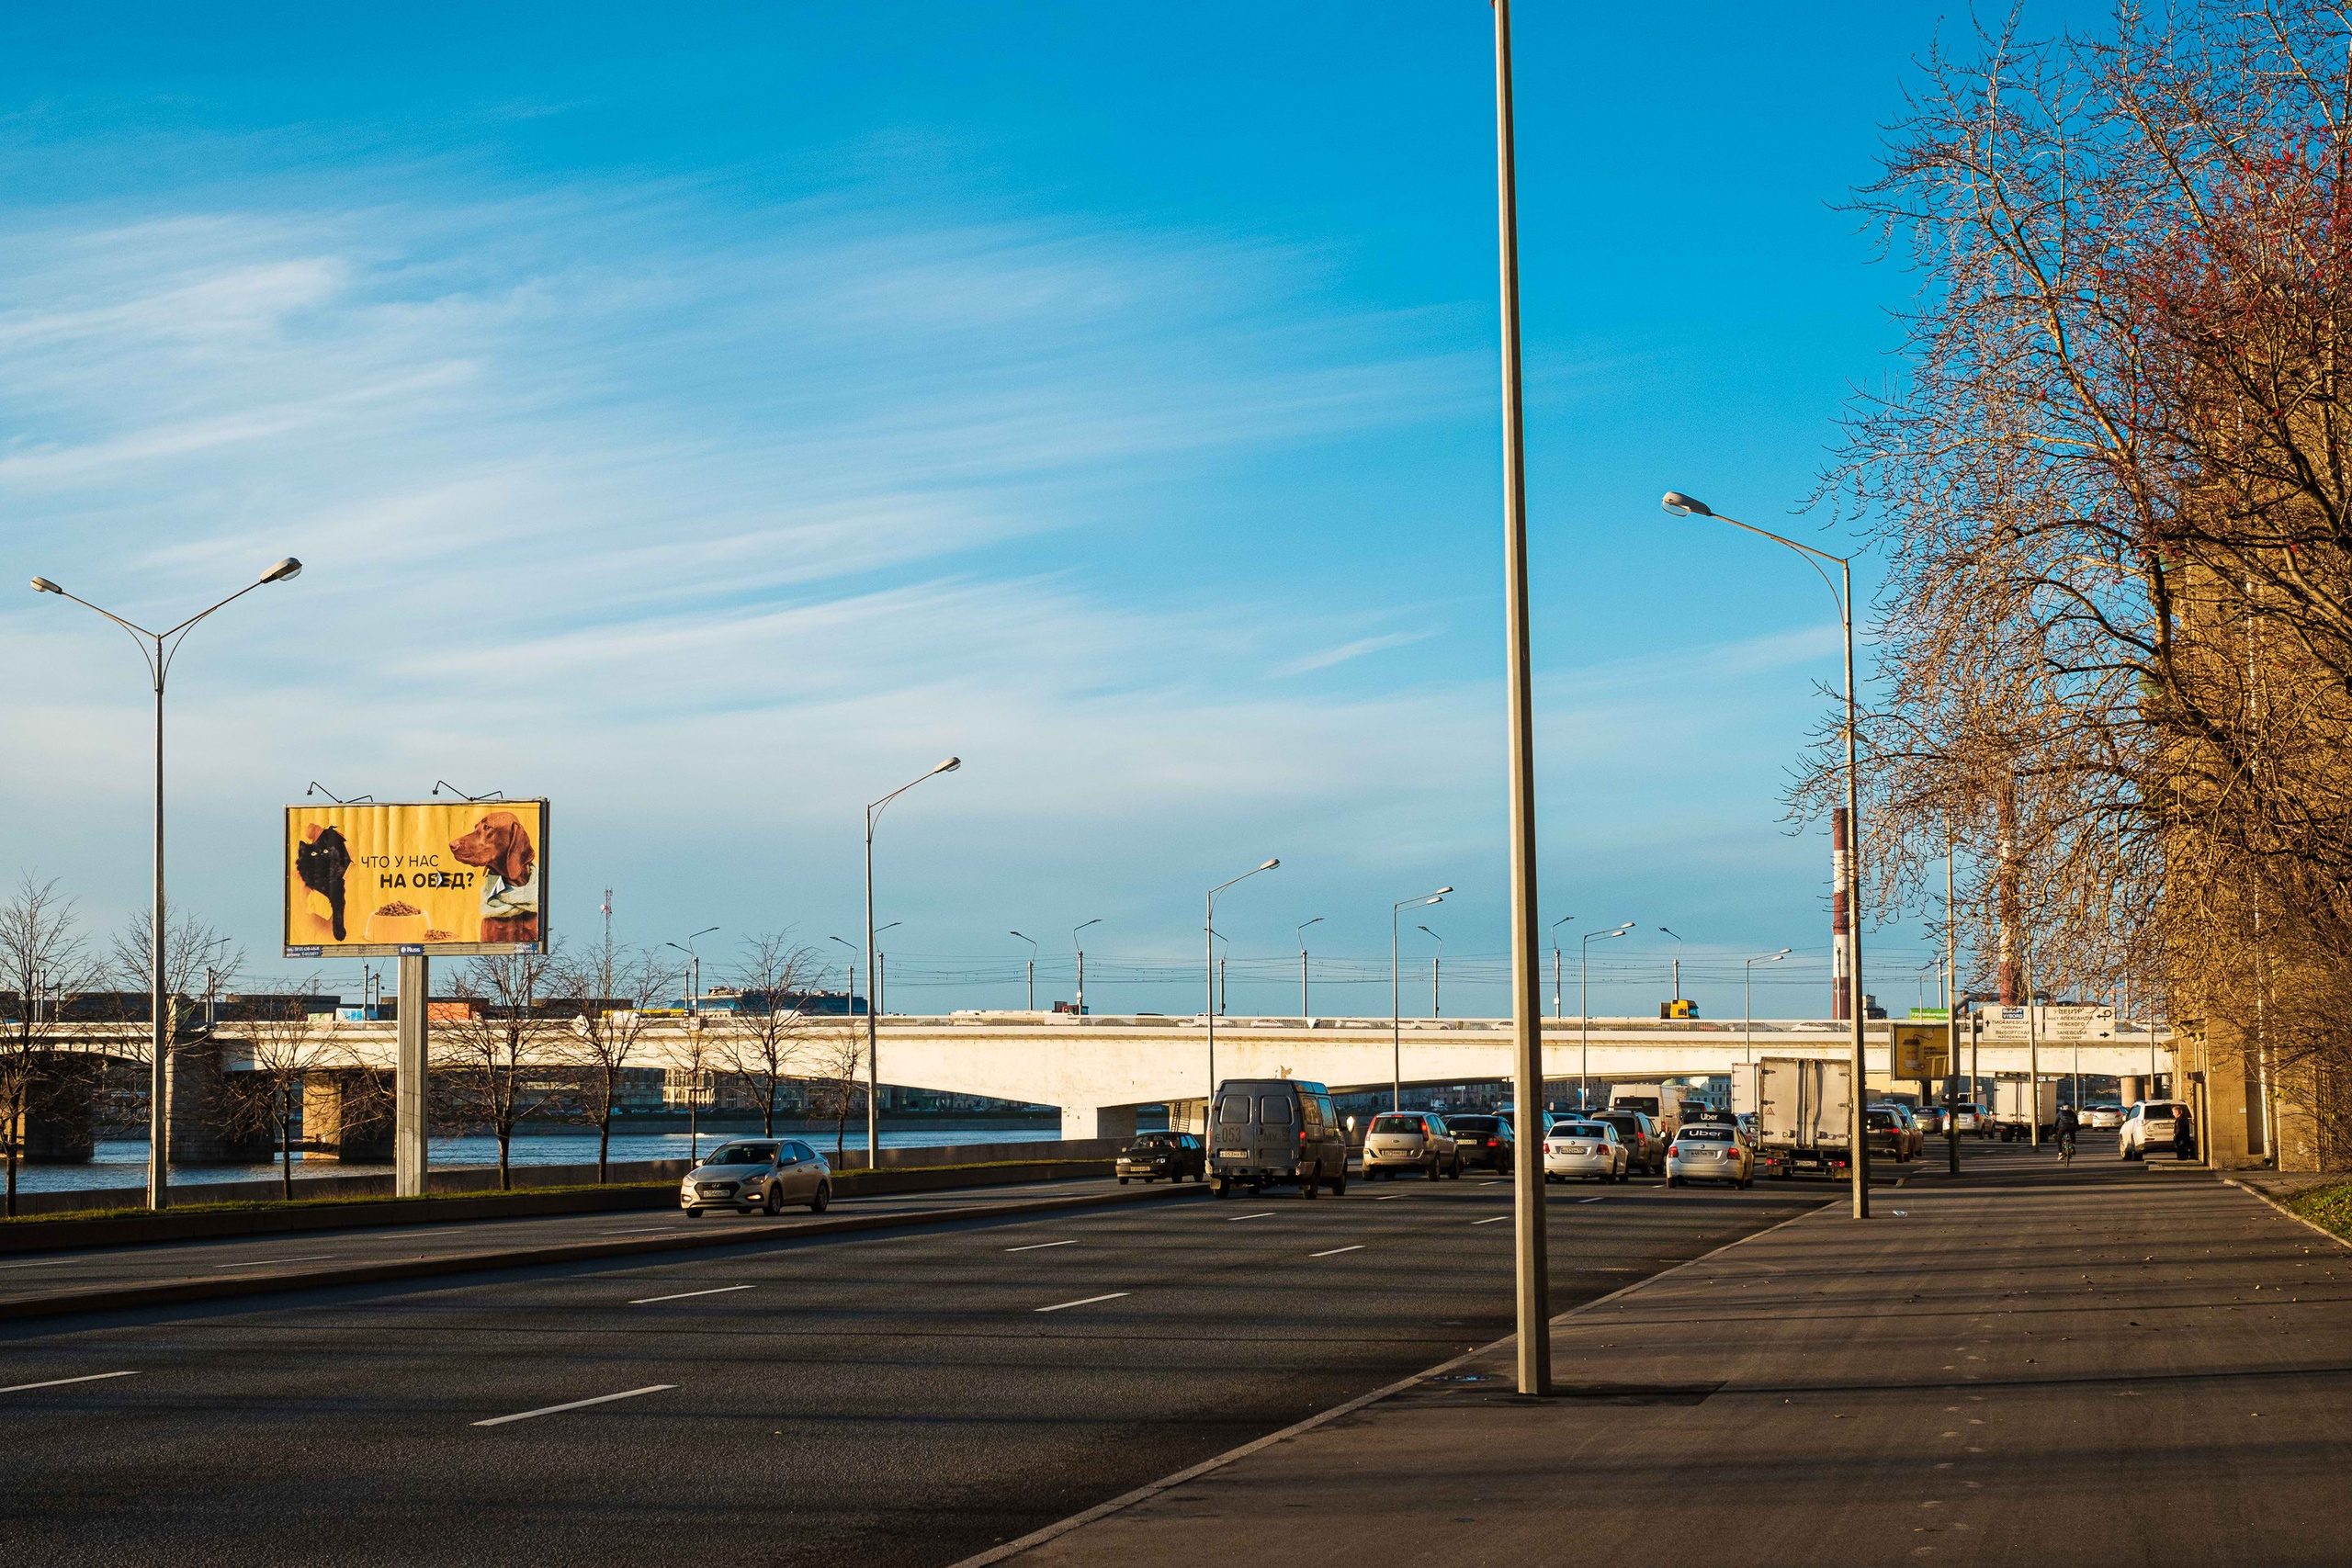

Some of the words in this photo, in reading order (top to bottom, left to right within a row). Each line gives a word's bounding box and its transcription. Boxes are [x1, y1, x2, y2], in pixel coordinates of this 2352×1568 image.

[361, 855, 390, 868] ЧТО
[395, 855, 404, 867] У
[409, 854, 439, 867] НАС
[380, 873, 406, 888] НА
